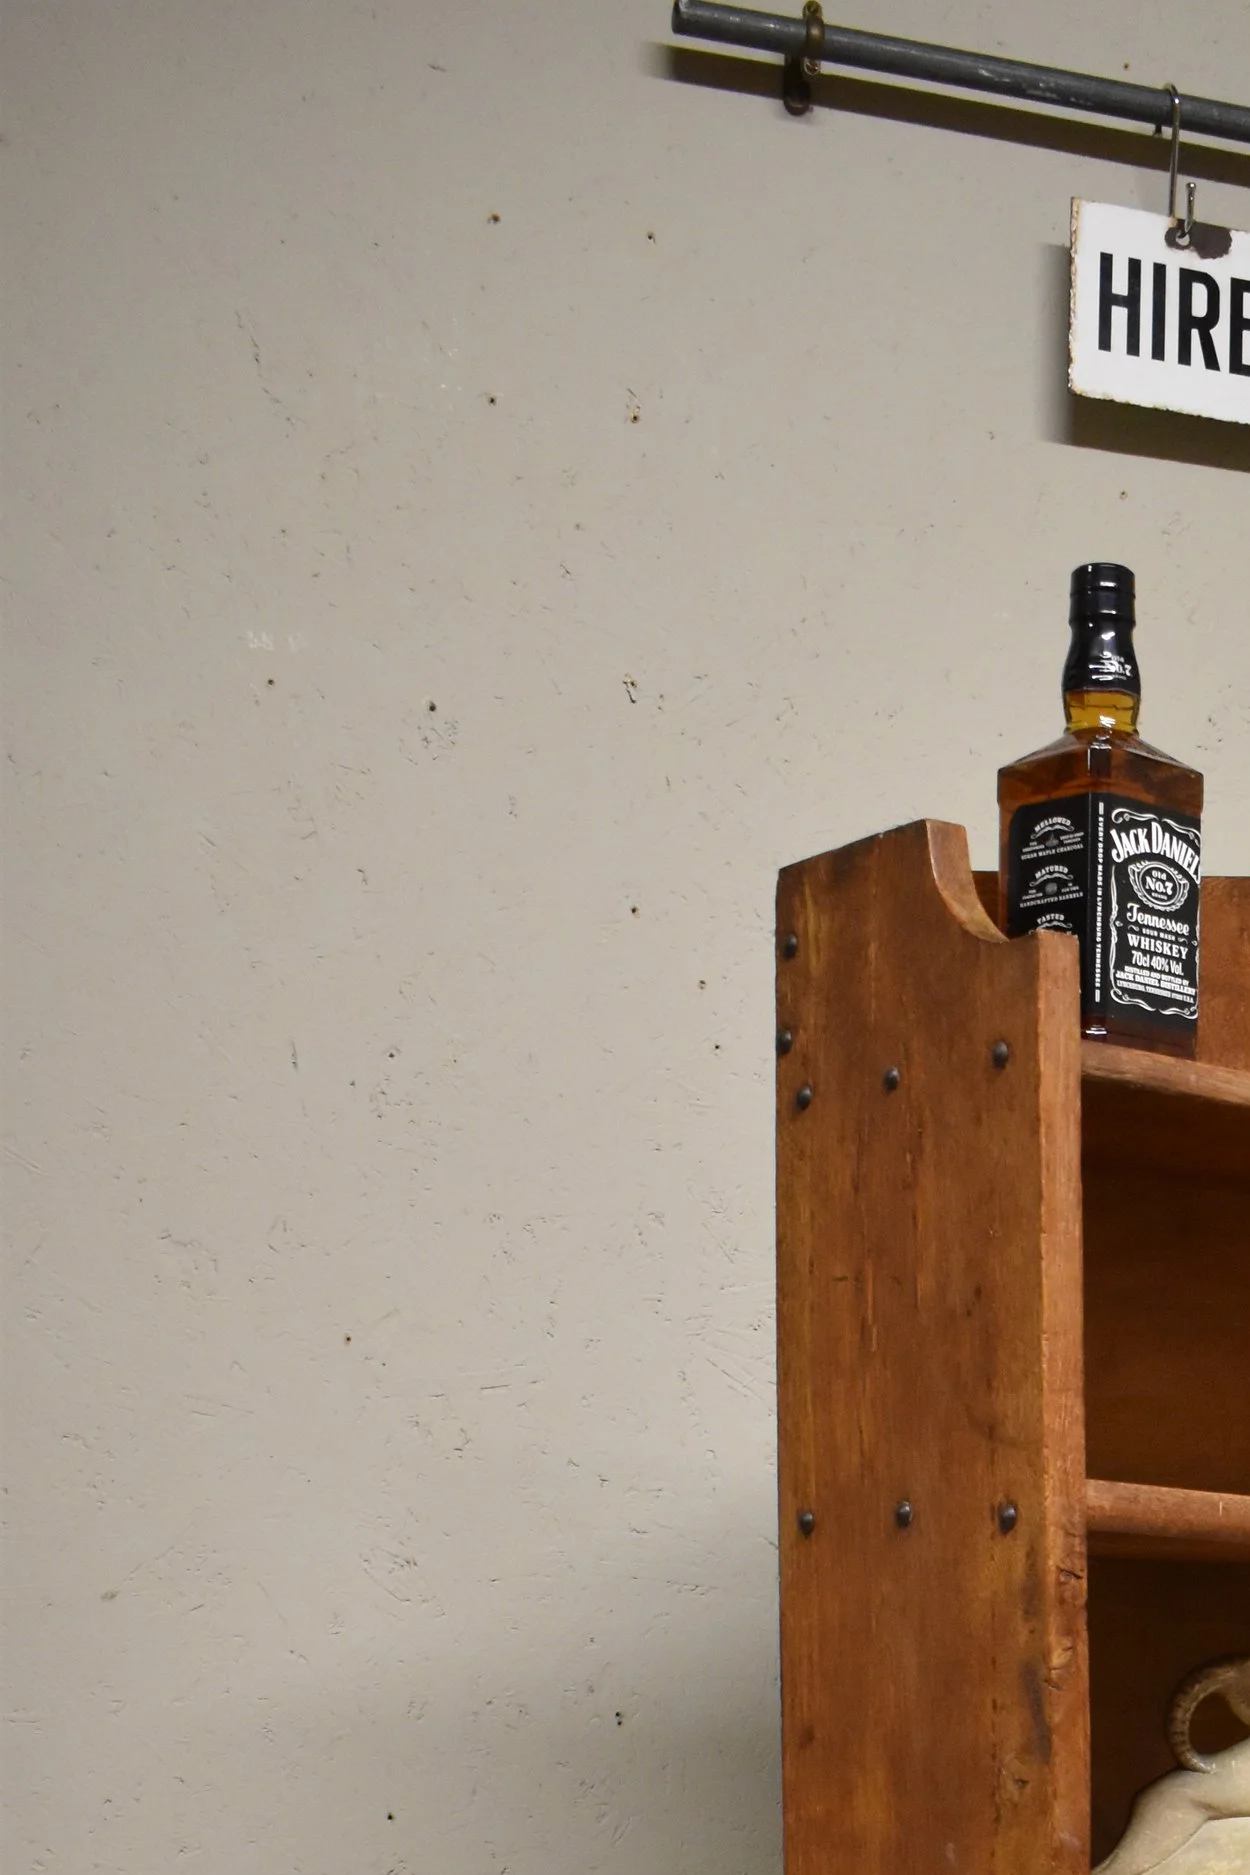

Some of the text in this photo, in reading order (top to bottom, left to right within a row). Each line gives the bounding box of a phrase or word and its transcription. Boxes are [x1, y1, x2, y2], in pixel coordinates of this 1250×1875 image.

[1110, 827, 1151, 862] JACK
[1035, 865, 1069, 879] MATURED
[1036, 913, 1065, 925] TASTED
[1126, 903, 1190, 936] Tennessee
[1127, 933, 1189, 960] WHISKEY
[1131, 950, 1150, 968] 70cl
[1150, 956, 1169, 973] 40%
